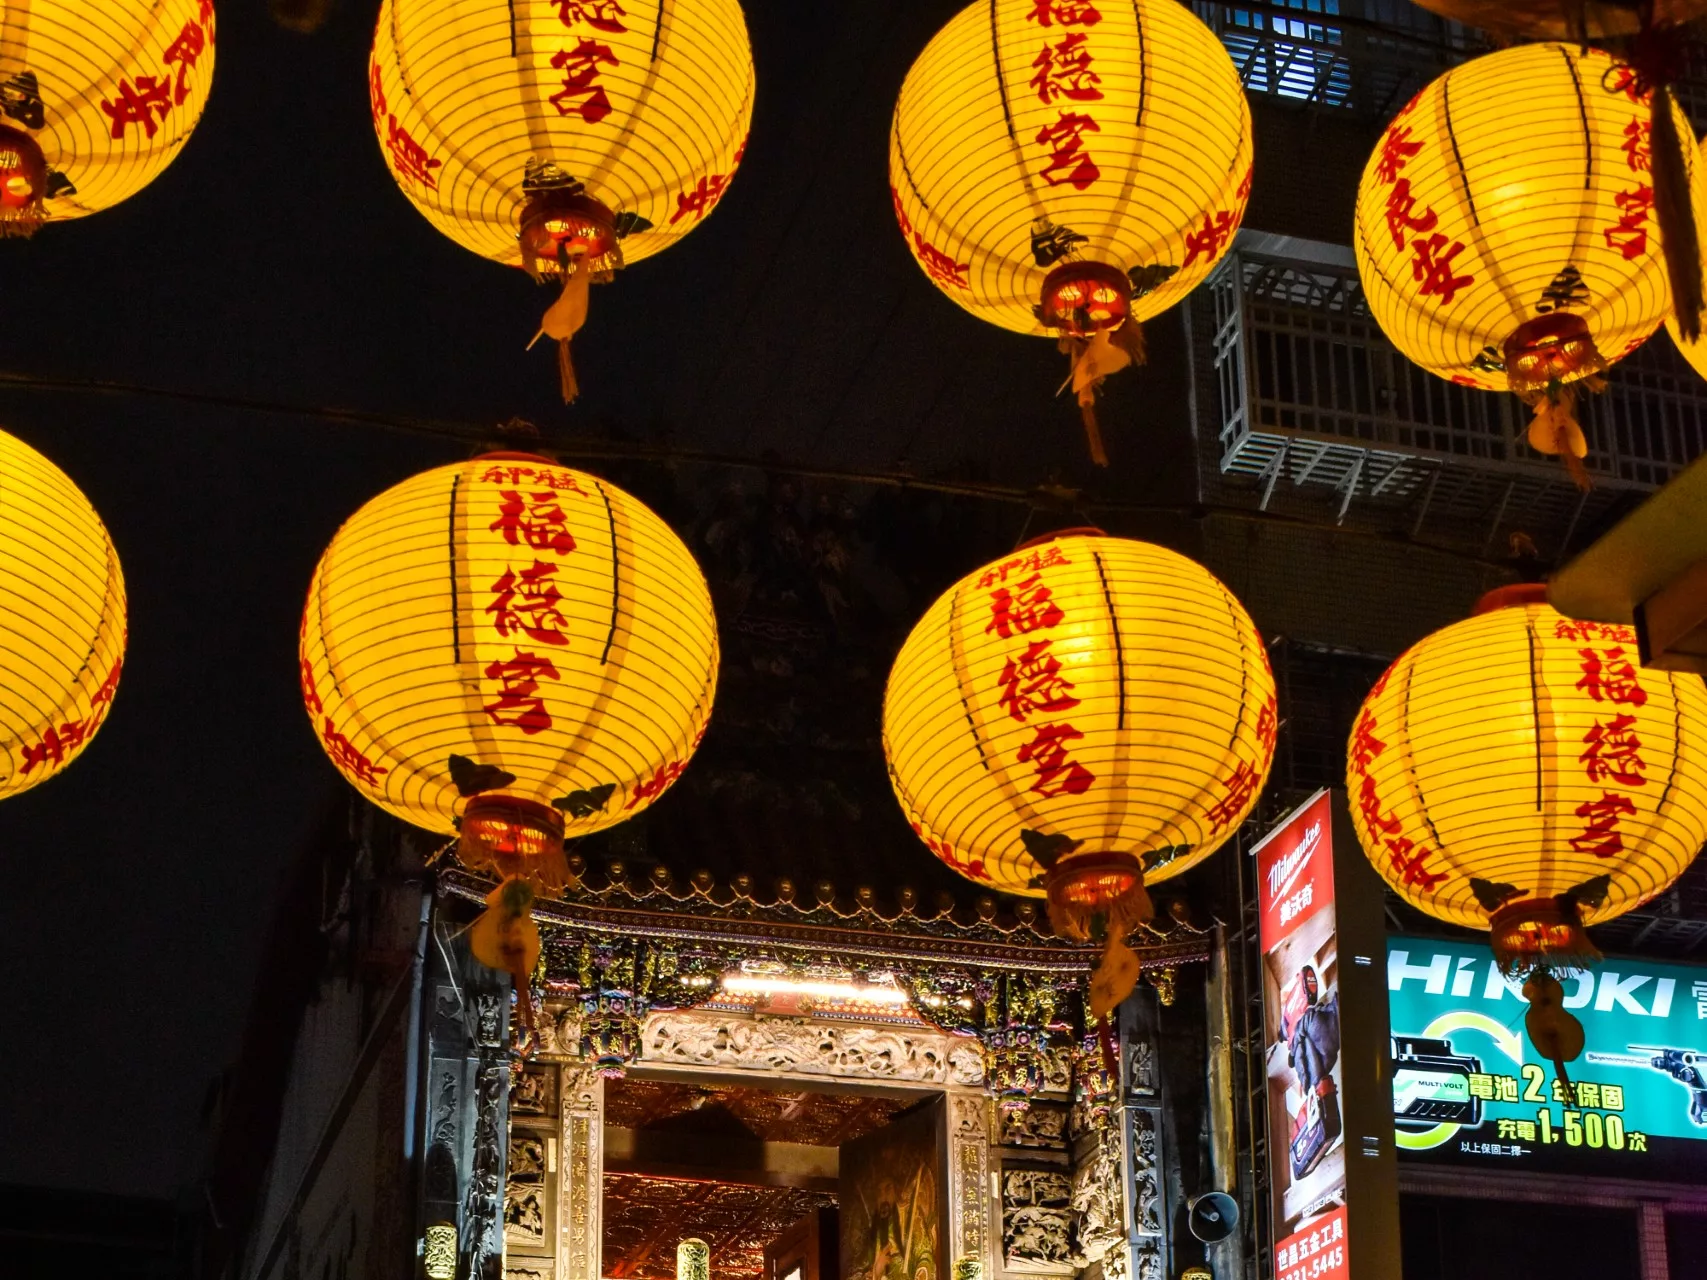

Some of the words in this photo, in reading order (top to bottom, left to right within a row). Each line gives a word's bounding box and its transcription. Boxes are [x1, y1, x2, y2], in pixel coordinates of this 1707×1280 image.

[485, 490, 577, 735] 福德宮
[985, 573, 1096, 798] 福德宮
[1568, 646, 1648, 859] 福德宮
[1267, 820, 1321, 898] Milwaukee
[1443, 1082, 1464, 1090] VOLT
[1278, 1217, 1343, 1272] 世昌五金工具
